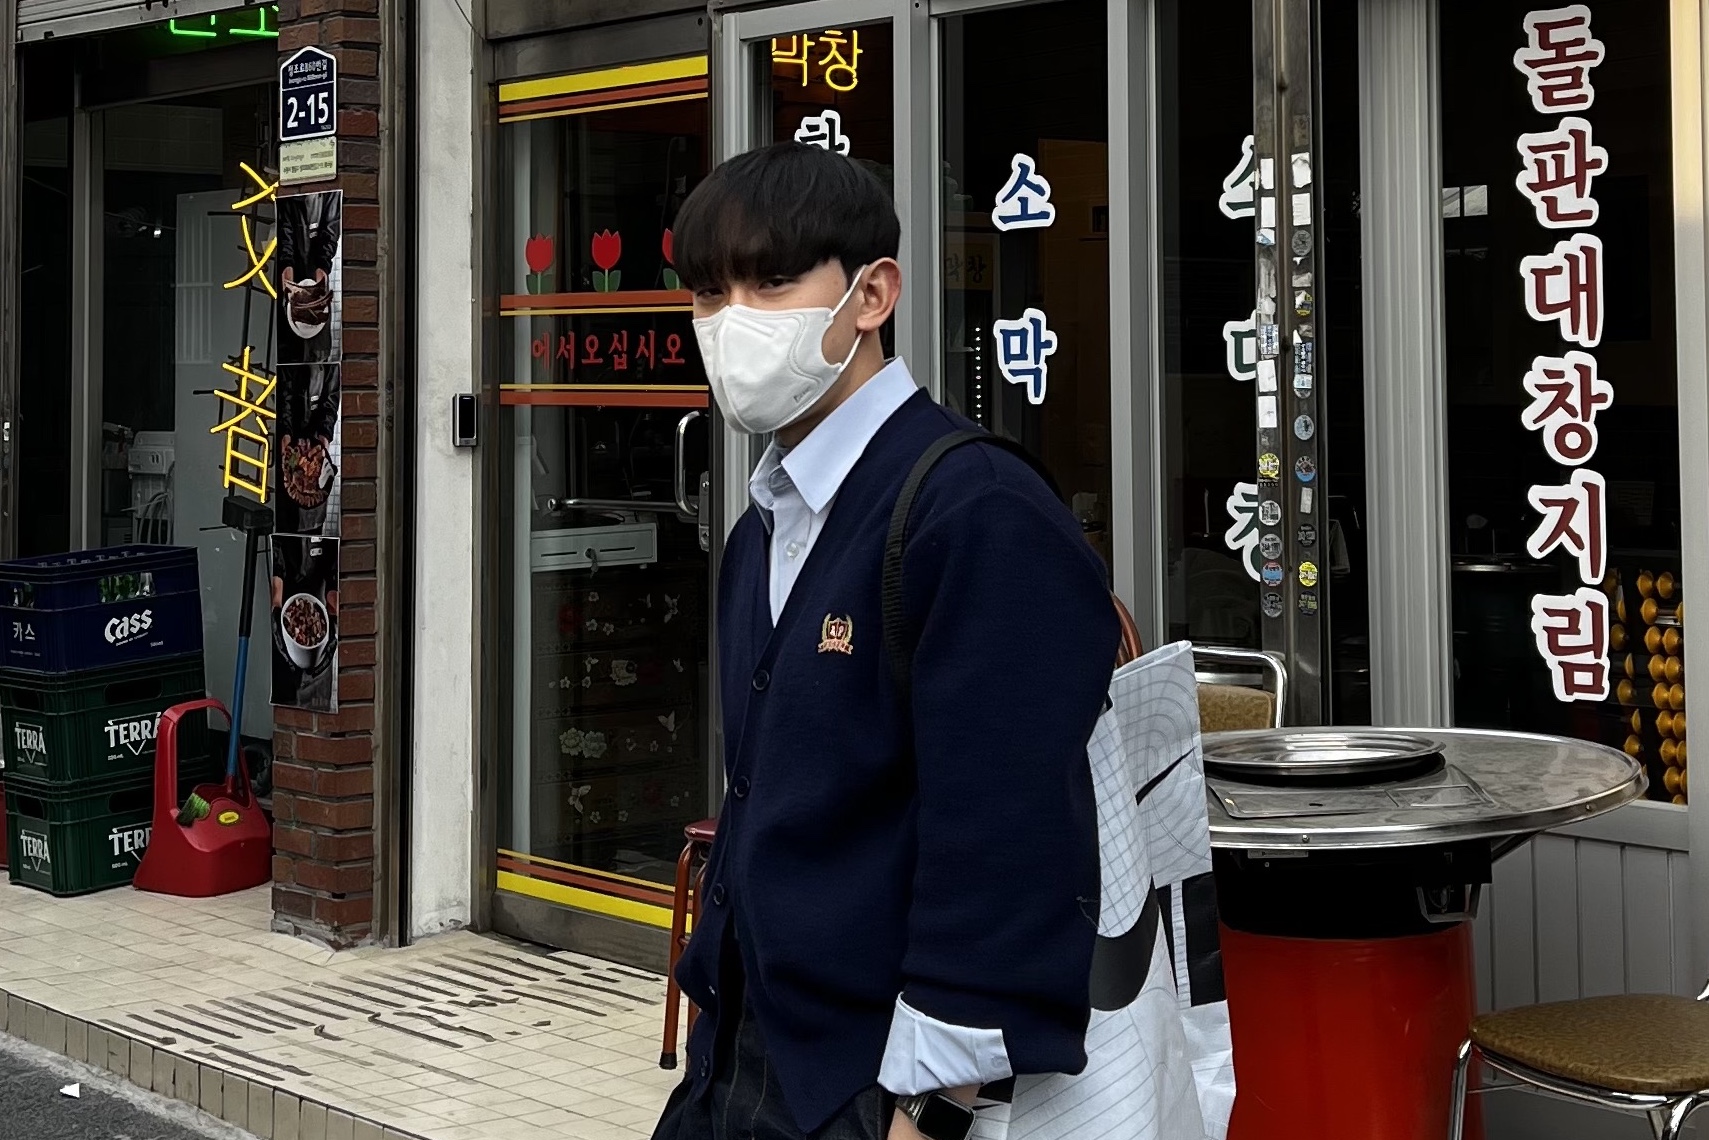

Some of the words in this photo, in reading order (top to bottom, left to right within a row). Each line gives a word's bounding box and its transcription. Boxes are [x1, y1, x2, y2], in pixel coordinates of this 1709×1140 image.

[286, 91, 329, 129] 2-15
[531, 329, 686, 372] 어서오십시오
[1520, 12, 1612, 699] 돌판대창지림
[12, 621, 36, 642] 카스
[104, 608, 153, 644] Cass
[14, 726, 47, 755] TERRA
[20, 834, 51, 864] TERRA
